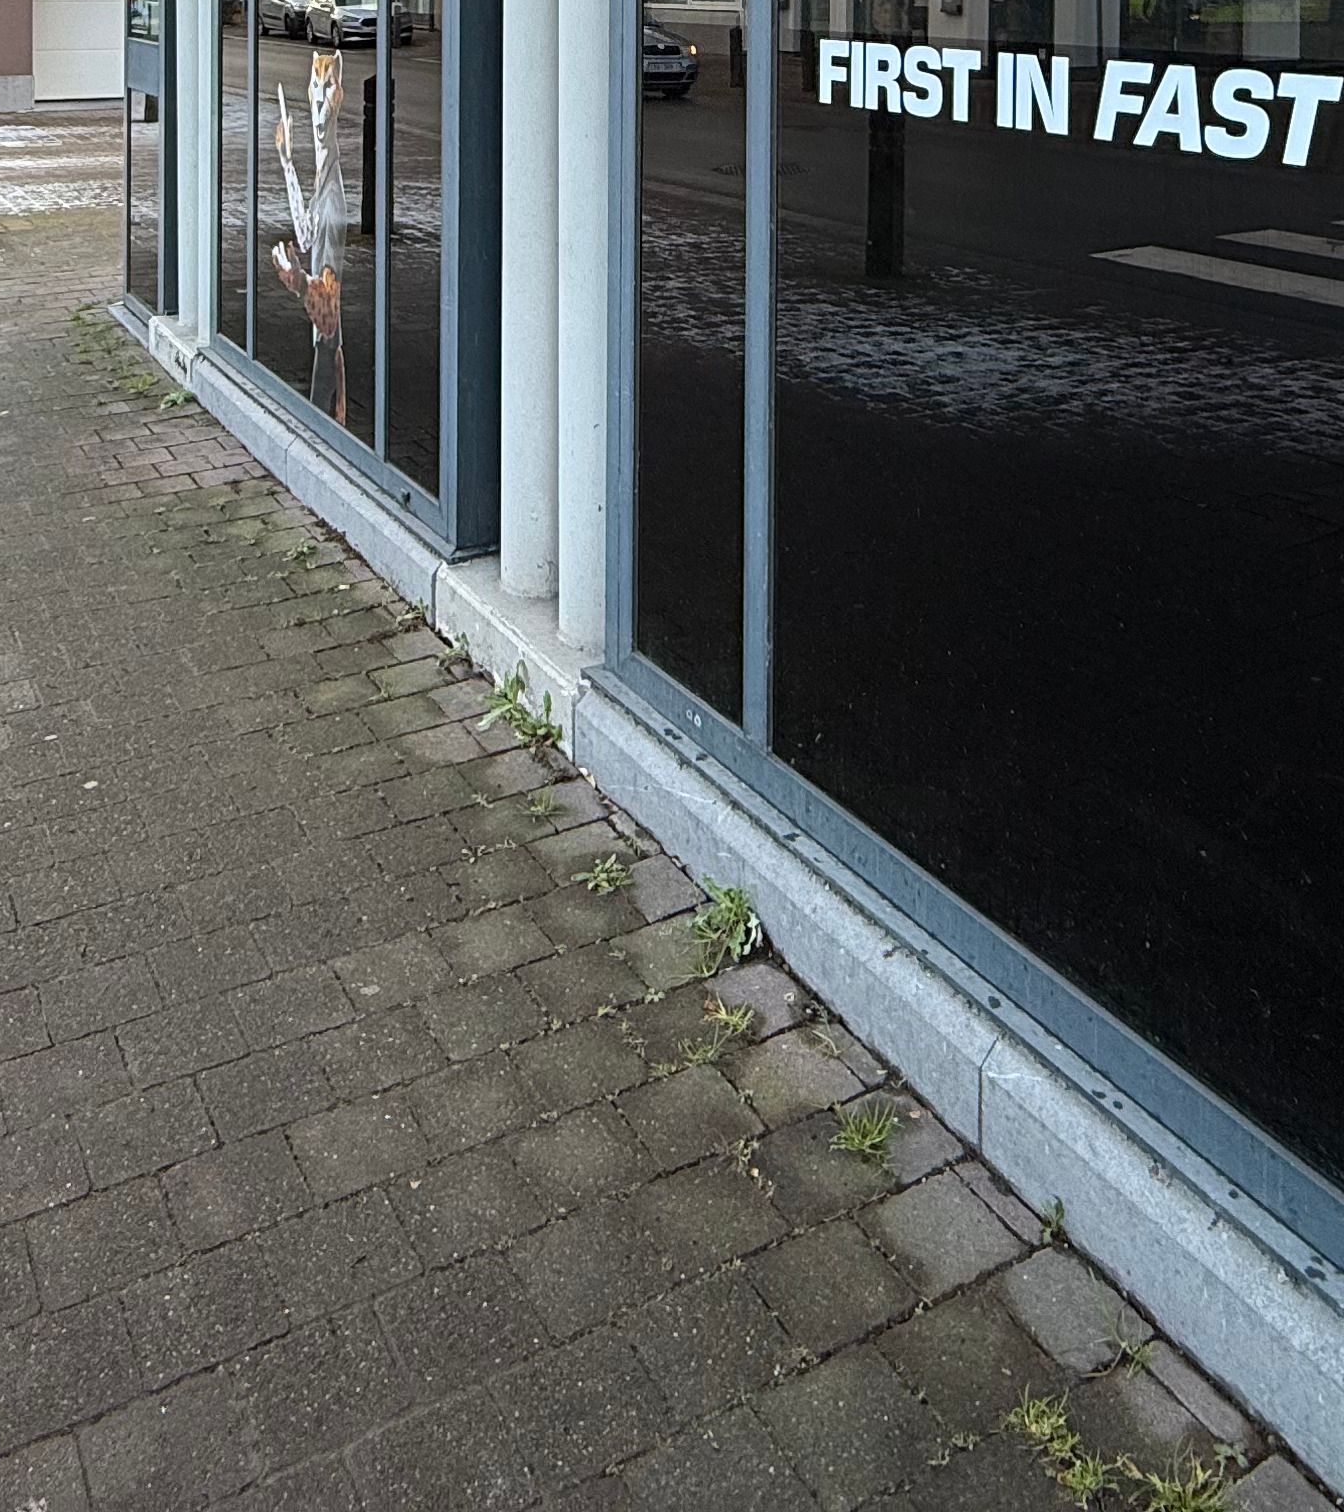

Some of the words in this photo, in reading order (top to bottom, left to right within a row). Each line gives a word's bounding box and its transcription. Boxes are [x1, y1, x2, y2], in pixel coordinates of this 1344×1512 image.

[818, 38, 982, 123] FIRST
[996, 52, 1070, 136] IN
[1093, 59, 1344, 168] FAST
